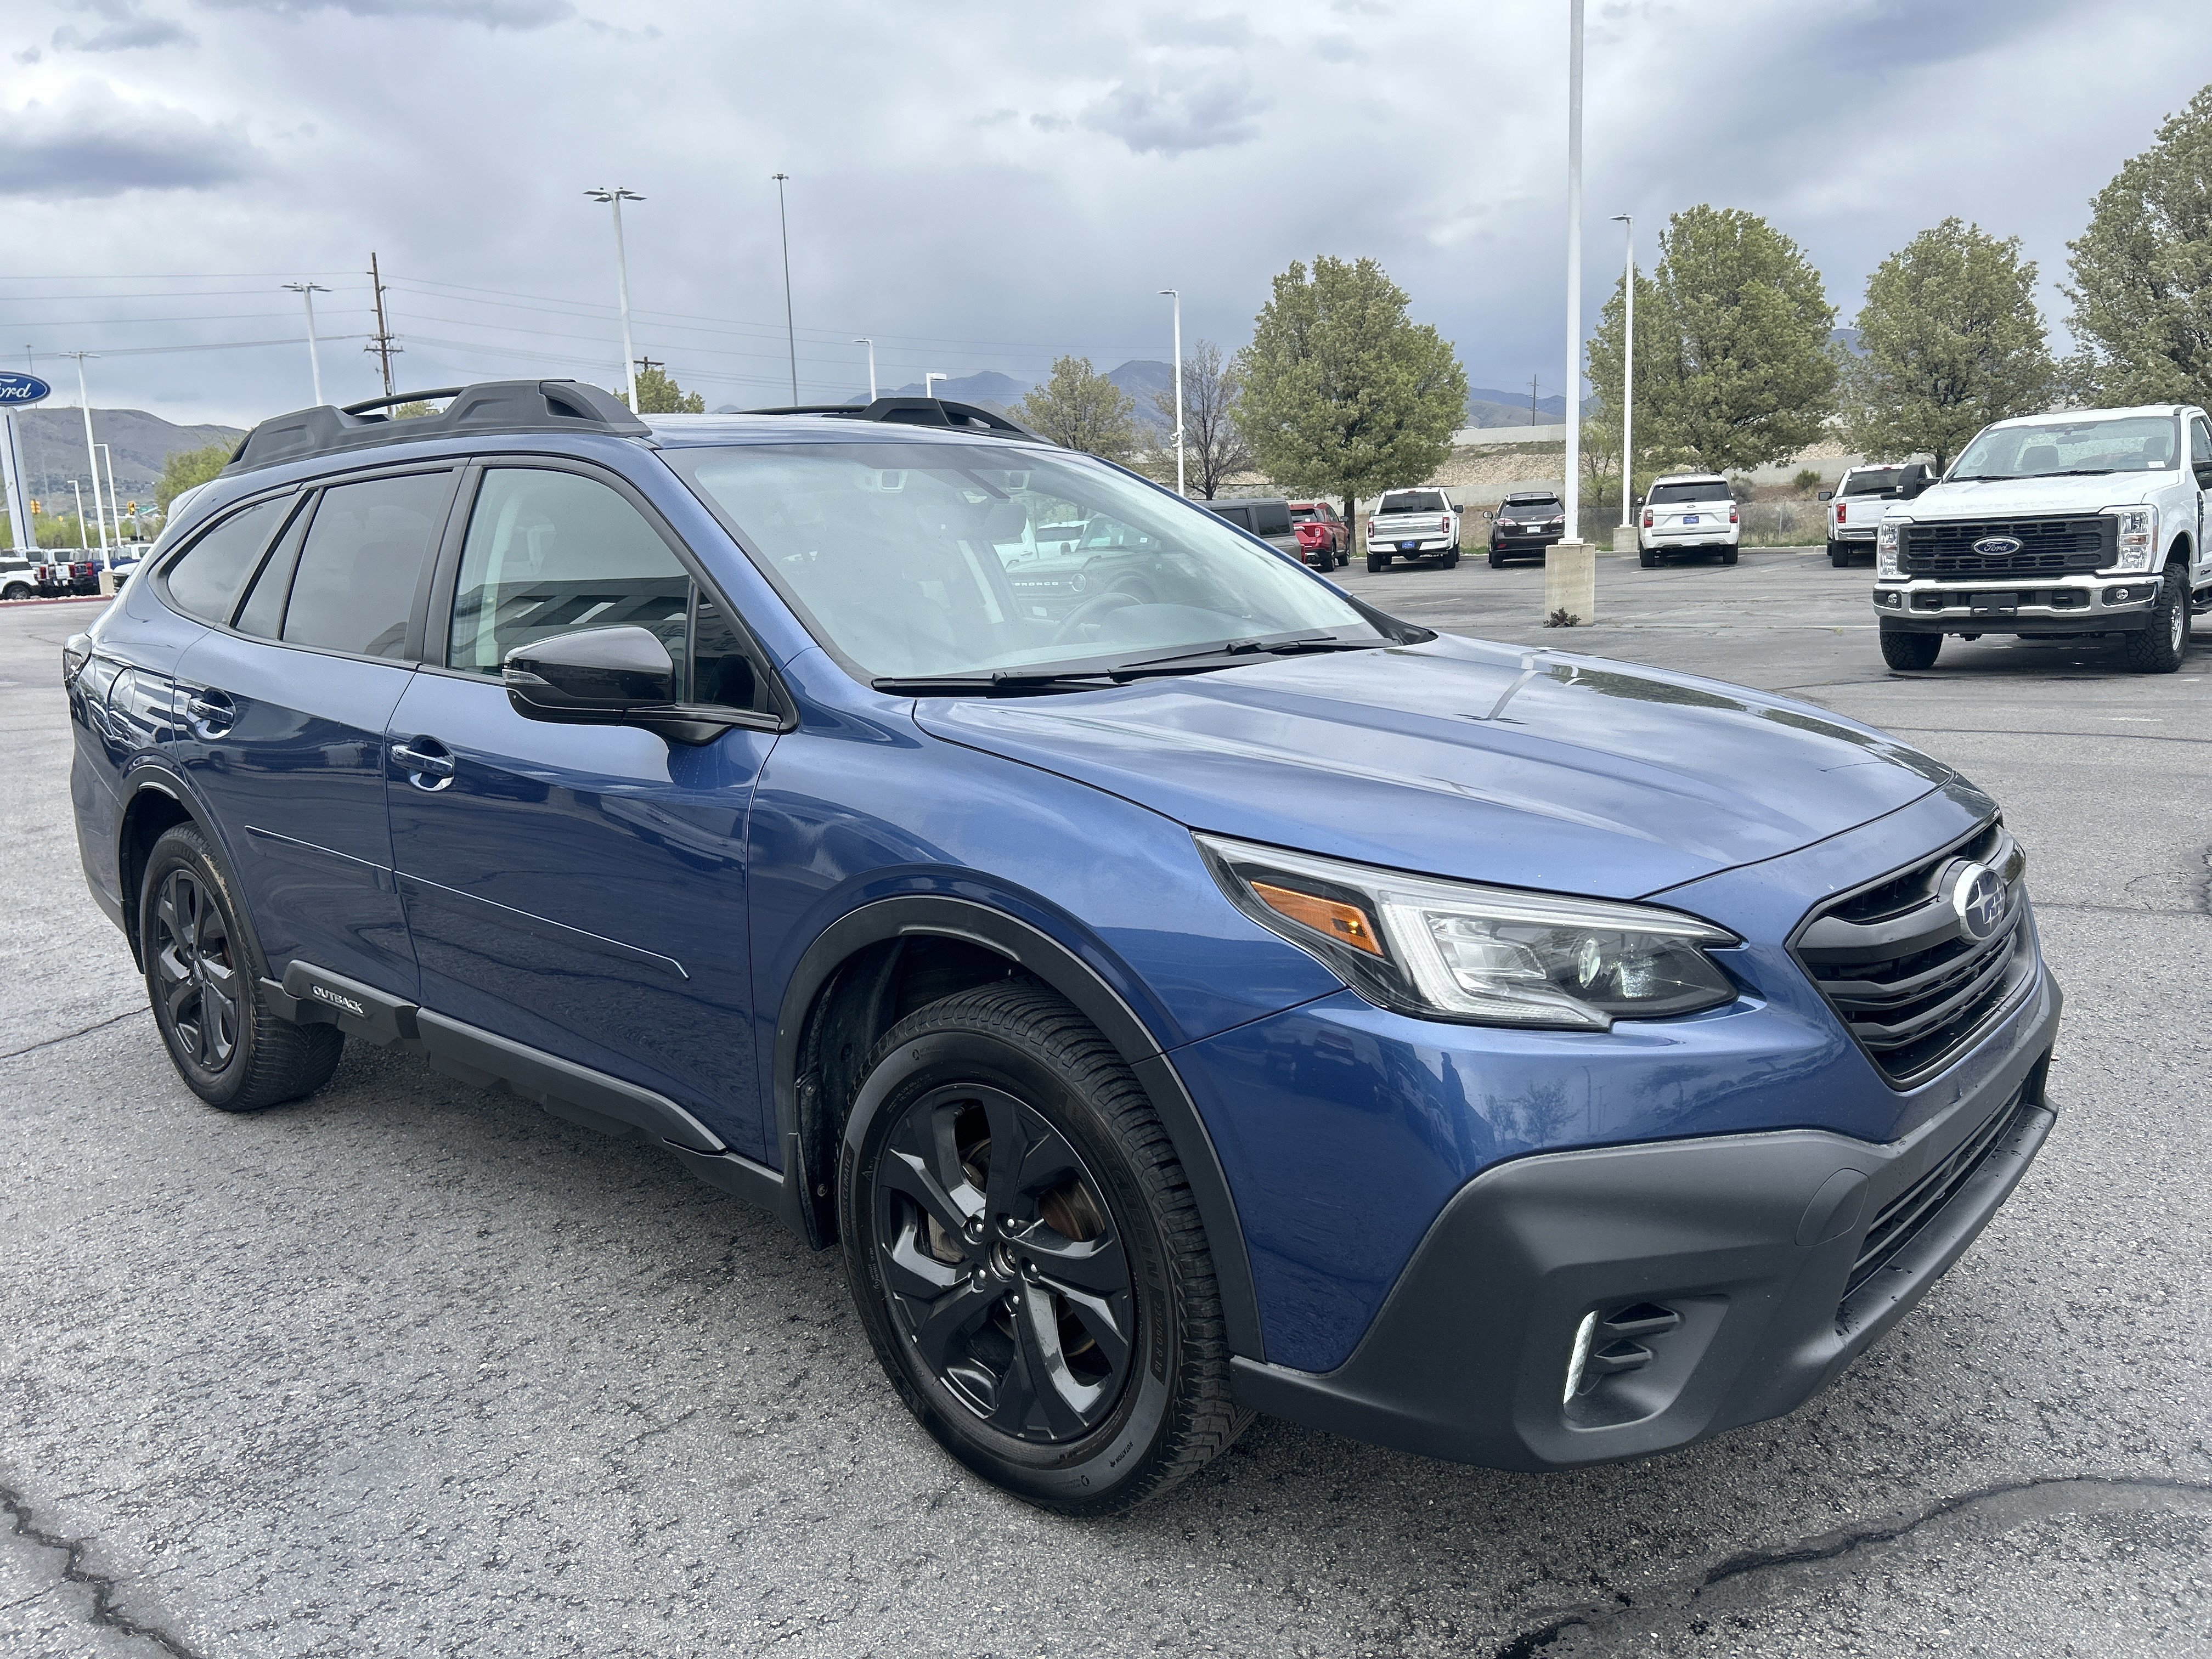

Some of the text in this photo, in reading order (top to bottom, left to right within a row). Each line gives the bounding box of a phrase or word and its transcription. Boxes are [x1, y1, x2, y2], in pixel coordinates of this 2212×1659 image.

[1983, 541, 2008, 552] Ford
[313, 985, 364, 1014] OUTBACK
[1154, 1300, 1163, 1373] 225/60 R 18
[1115, 1440, 1133, 1464] ROTATION
